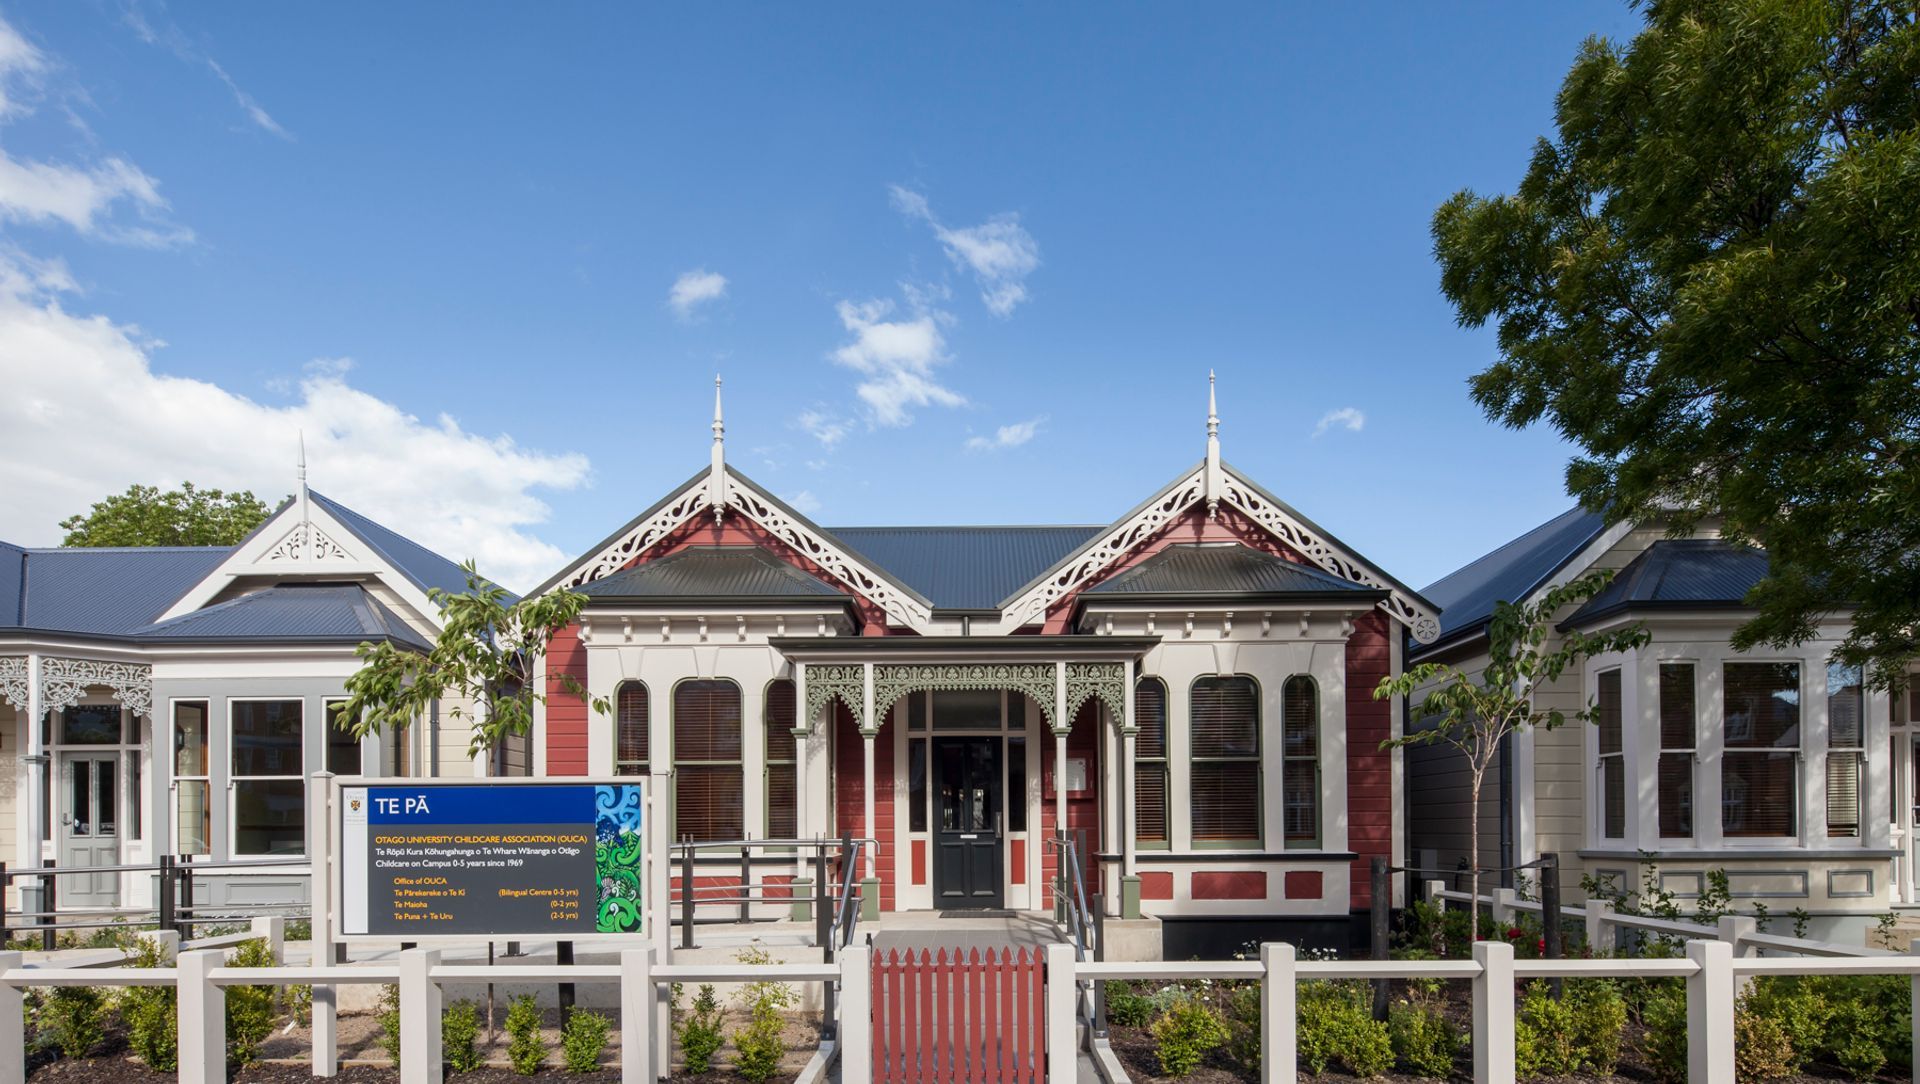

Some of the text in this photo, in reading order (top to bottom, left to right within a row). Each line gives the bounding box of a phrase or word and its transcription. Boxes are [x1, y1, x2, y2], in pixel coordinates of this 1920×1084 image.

[375, 795, 430, 814] TE PĀ
[375, 836, 405, 844] OTAGO
[558, 836, 588, 844] (OUCA)
[422, 860, 451, 868] Campus
[508, 859, 523, 867] 1969
[498, 889, 528, 897] (Bilingual
[566, 889, 579, 897] yrs)
[551, 900, 578, 908] (0-2 yrs)
[551, 912, 578, 920] (2-5 yrs)
